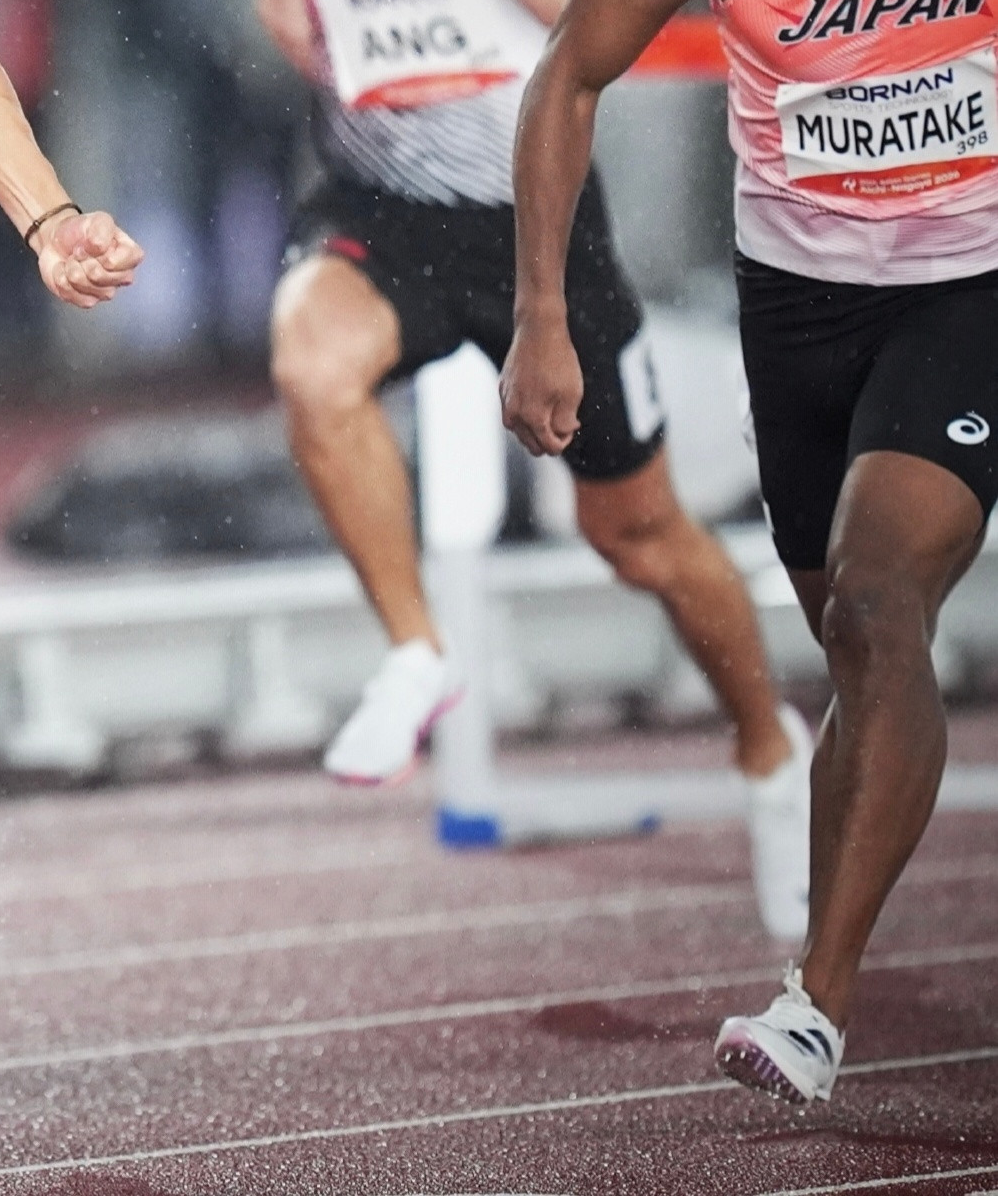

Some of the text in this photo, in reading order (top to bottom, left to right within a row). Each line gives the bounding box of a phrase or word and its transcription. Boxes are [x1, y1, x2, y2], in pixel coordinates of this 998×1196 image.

[361, 15, 468, 59] ANG
[825, 67, 954, 102] BORNAN
[796, 91, 985, 157] MURATAKE
[956, 131, 989, 155] 398
